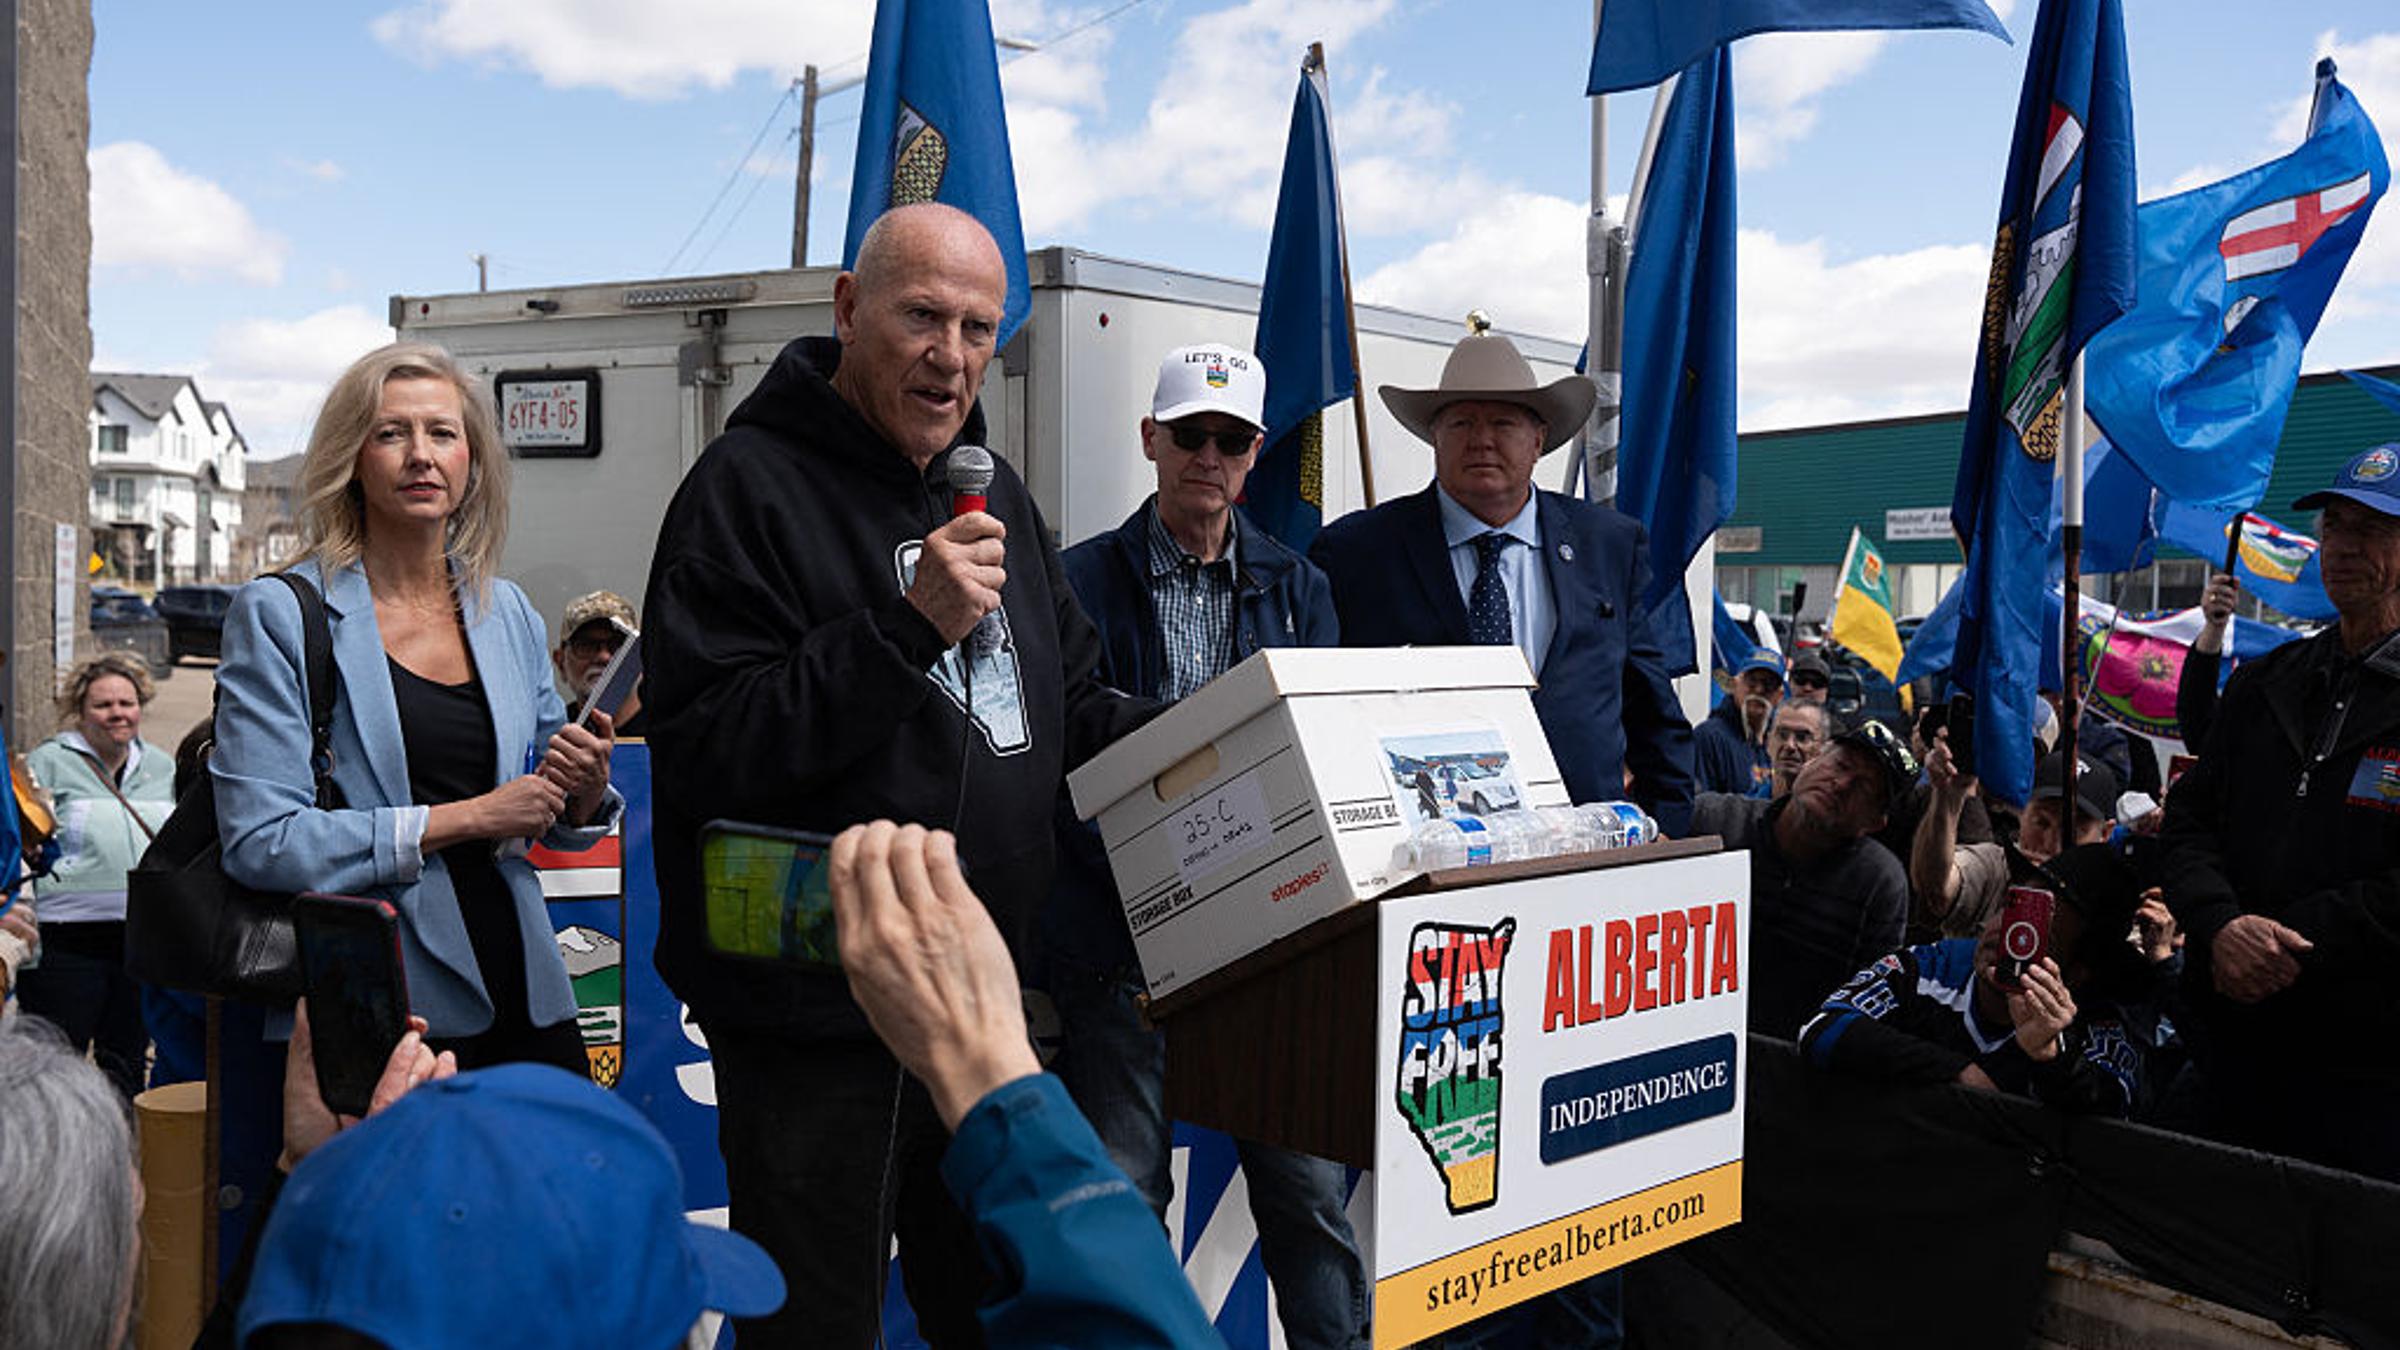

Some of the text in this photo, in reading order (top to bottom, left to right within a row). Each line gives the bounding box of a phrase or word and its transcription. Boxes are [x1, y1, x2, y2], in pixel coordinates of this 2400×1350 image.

[1185, 352, 1248, 371] LET'S GO
[509, 400, 578, 430] 6YF4-05
[1183, 799, 1235, 844] 25-C
[1332, 804, 1384, 825] STORAGE
[1129, 884, 1194, 930] STORAGE BOX
[1270, 868, 1321, 902] staples
[1405, 922, 1510, 1029] STAY
[1542, 901, 1739, 1033] ALBERTA
[1399, 1016, 1500, 1130] FREE
[1549, 1061, 1728, 1134] INDEPENDENCE
[1426, 1190, 1706, 1312] stayfreealberta.com
